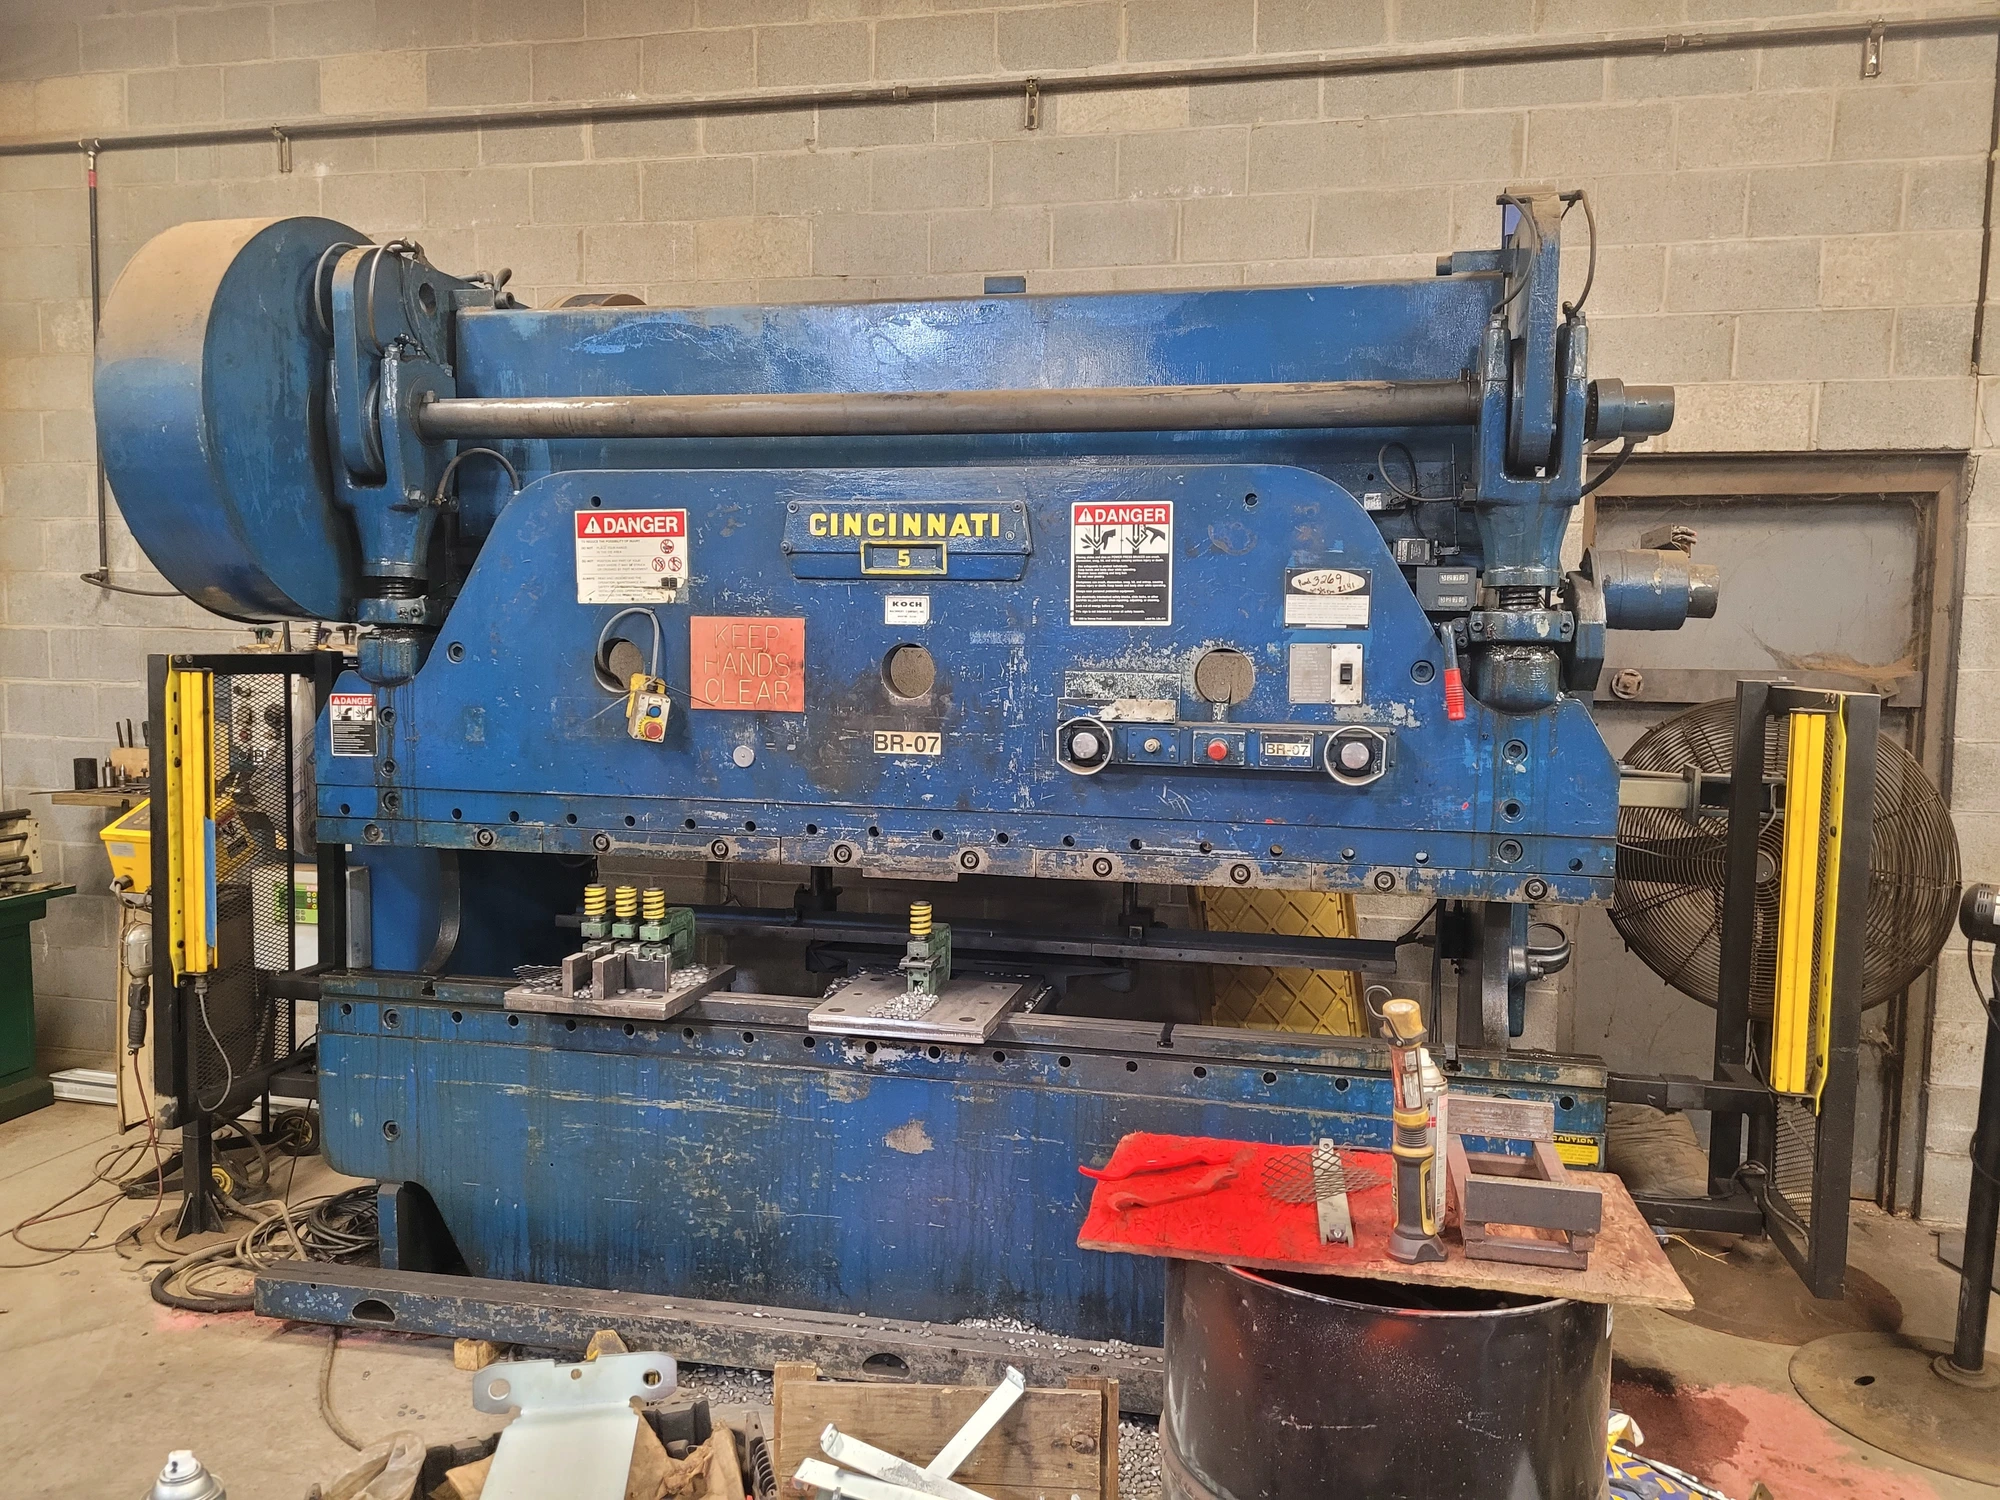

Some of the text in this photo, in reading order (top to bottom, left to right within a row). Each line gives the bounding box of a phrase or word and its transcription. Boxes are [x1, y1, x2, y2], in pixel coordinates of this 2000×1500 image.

[603, 516, 678, 534] DANGER
[809, 512, 999, 537] CINCINNATI
[1095, 508, 1166, 523] DANGER
[898, 549, 910, 566] 5
[1312, 573, 1342, 587] 3269
[714, 624, 780, 650] KEEP
[703, 652, 791, 678] HANDS
[704, 678, 791, 706] CLEAR
[874, 733, 940, 753] BR-07
[1266, 743, 1309, 756] BR-07
